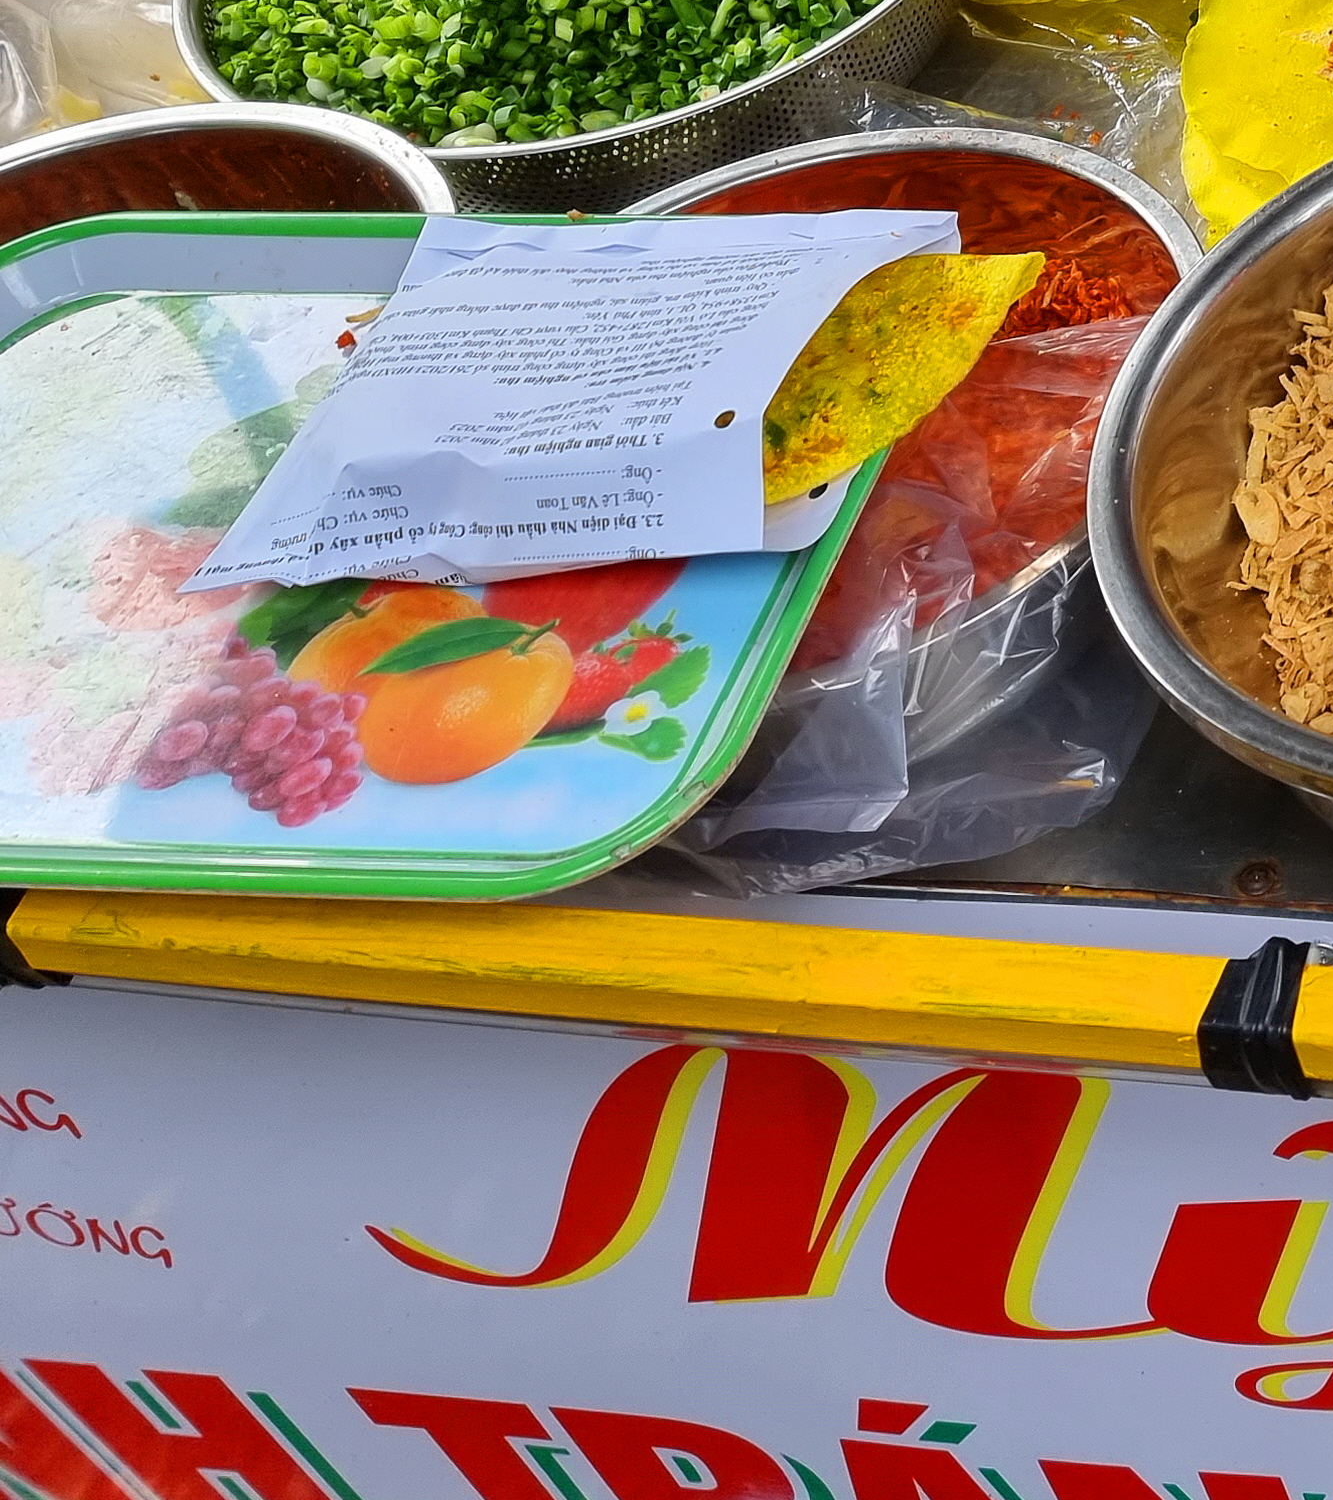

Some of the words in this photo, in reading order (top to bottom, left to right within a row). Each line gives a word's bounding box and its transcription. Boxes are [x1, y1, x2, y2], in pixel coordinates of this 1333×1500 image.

[534, 438, 582, 454] nghiệm
[585, 434, 614, 449] gian
[615, 434, 648, 448] Thời
[652, 432, 665, 445] 3.
[503, 445, 531, 457] thu:
[621, 465, 652, 484] Ông:
[342, 488, 365, 500] vụ:
[368, 485, 401, 498] Chức
[622, 488, 654, 508] Ông:
[536, 497, 569, 511] Toan
[571, 495, 598, 509] Văn
[602, 493, 619, 507] Lê
[343, 510, 367, 524] vụ:
[372, 506, 409, 520] Chức
[427, 522, 437, 534] ty
[468, 521, 493, 537] công:
[550, 520, 577, 535] Nhà
[582, 515, 610, 531] diện
[613, 513, 637, 530] Đại
[408, 527, 424, 543] cổ
[438, 522, 465, 537] Công
[495, 524, 514, 538] thi
[517, 522, 546, 539] thầu
[329, 537, 358, 552] xây
[364, 526, 403, 550] phần
